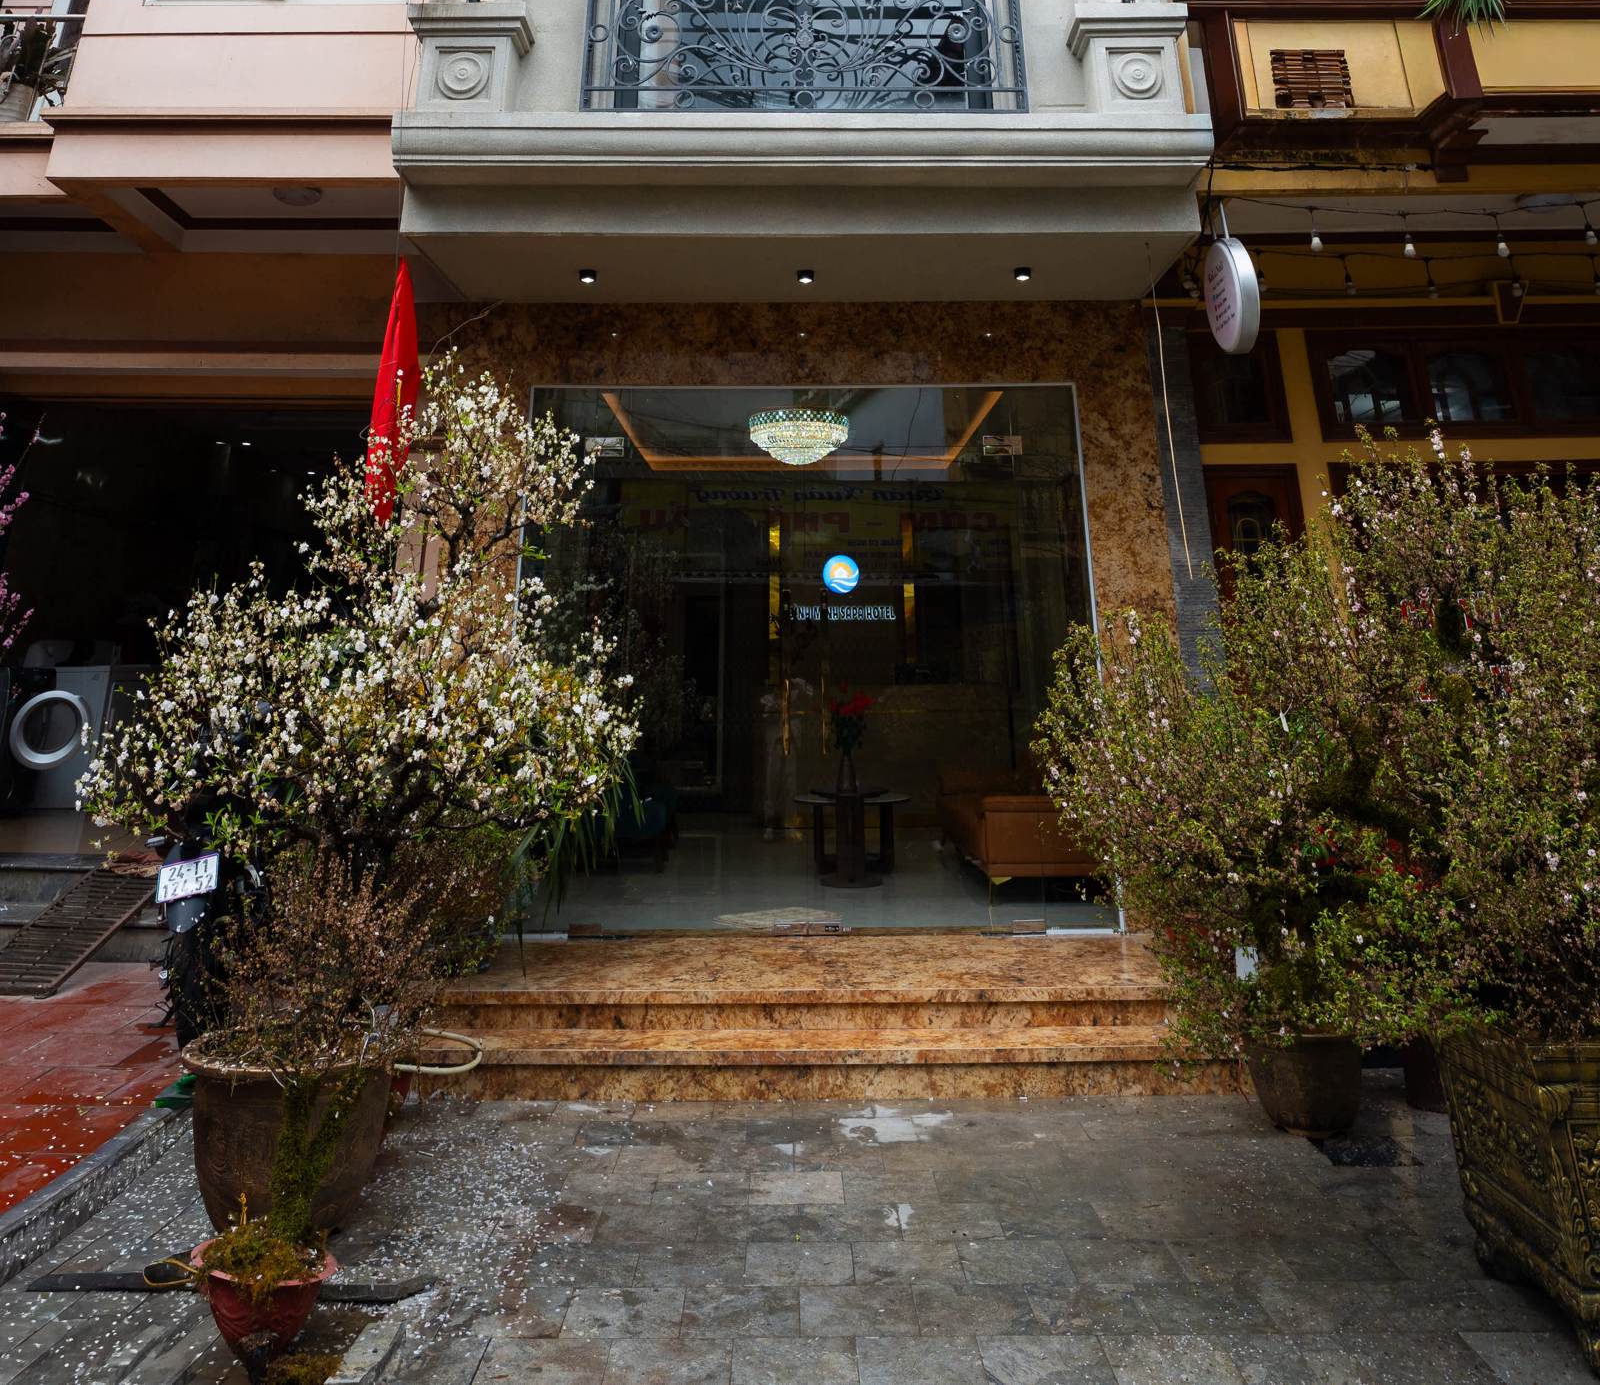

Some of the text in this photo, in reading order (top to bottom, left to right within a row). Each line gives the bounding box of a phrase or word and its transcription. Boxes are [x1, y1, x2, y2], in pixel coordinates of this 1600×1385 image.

[813, 605, 839, 621] MNH
[840, 605, 865, 621] SAPA
[866, 605, 897, 621] HOTEL
